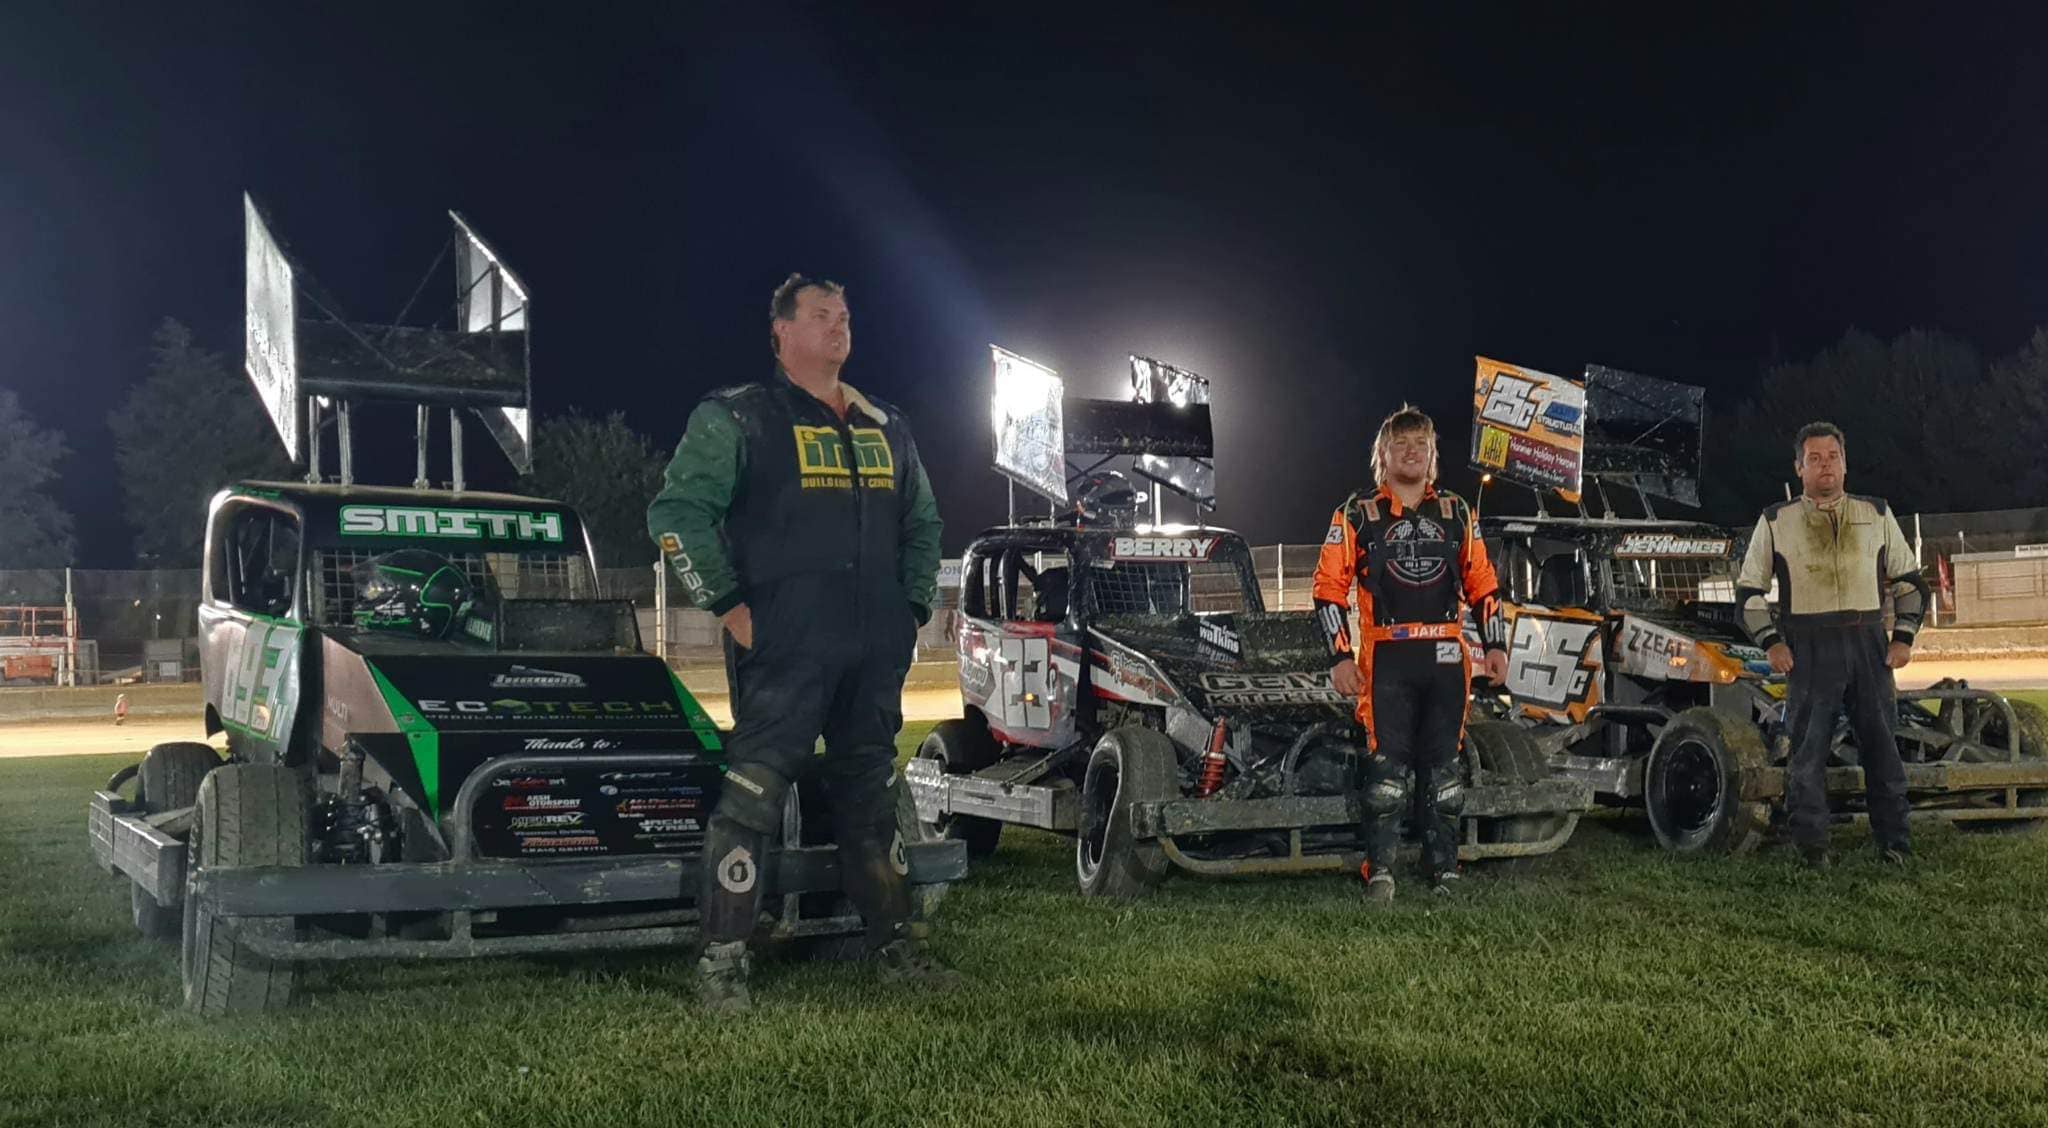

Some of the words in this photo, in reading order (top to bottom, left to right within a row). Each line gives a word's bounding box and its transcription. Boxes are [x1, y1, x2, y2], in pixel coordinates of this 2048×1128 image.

[1533, 446, 1556, 464] Holiday
[342, 506, 562, 541] SMITH
[1114, 537, 1213, 557] BERRY
[1409, 626, 1447, 639] JAKE
[1202, 672, 1338, 691] GEM
[523, 737, 586, 750] Thanks
